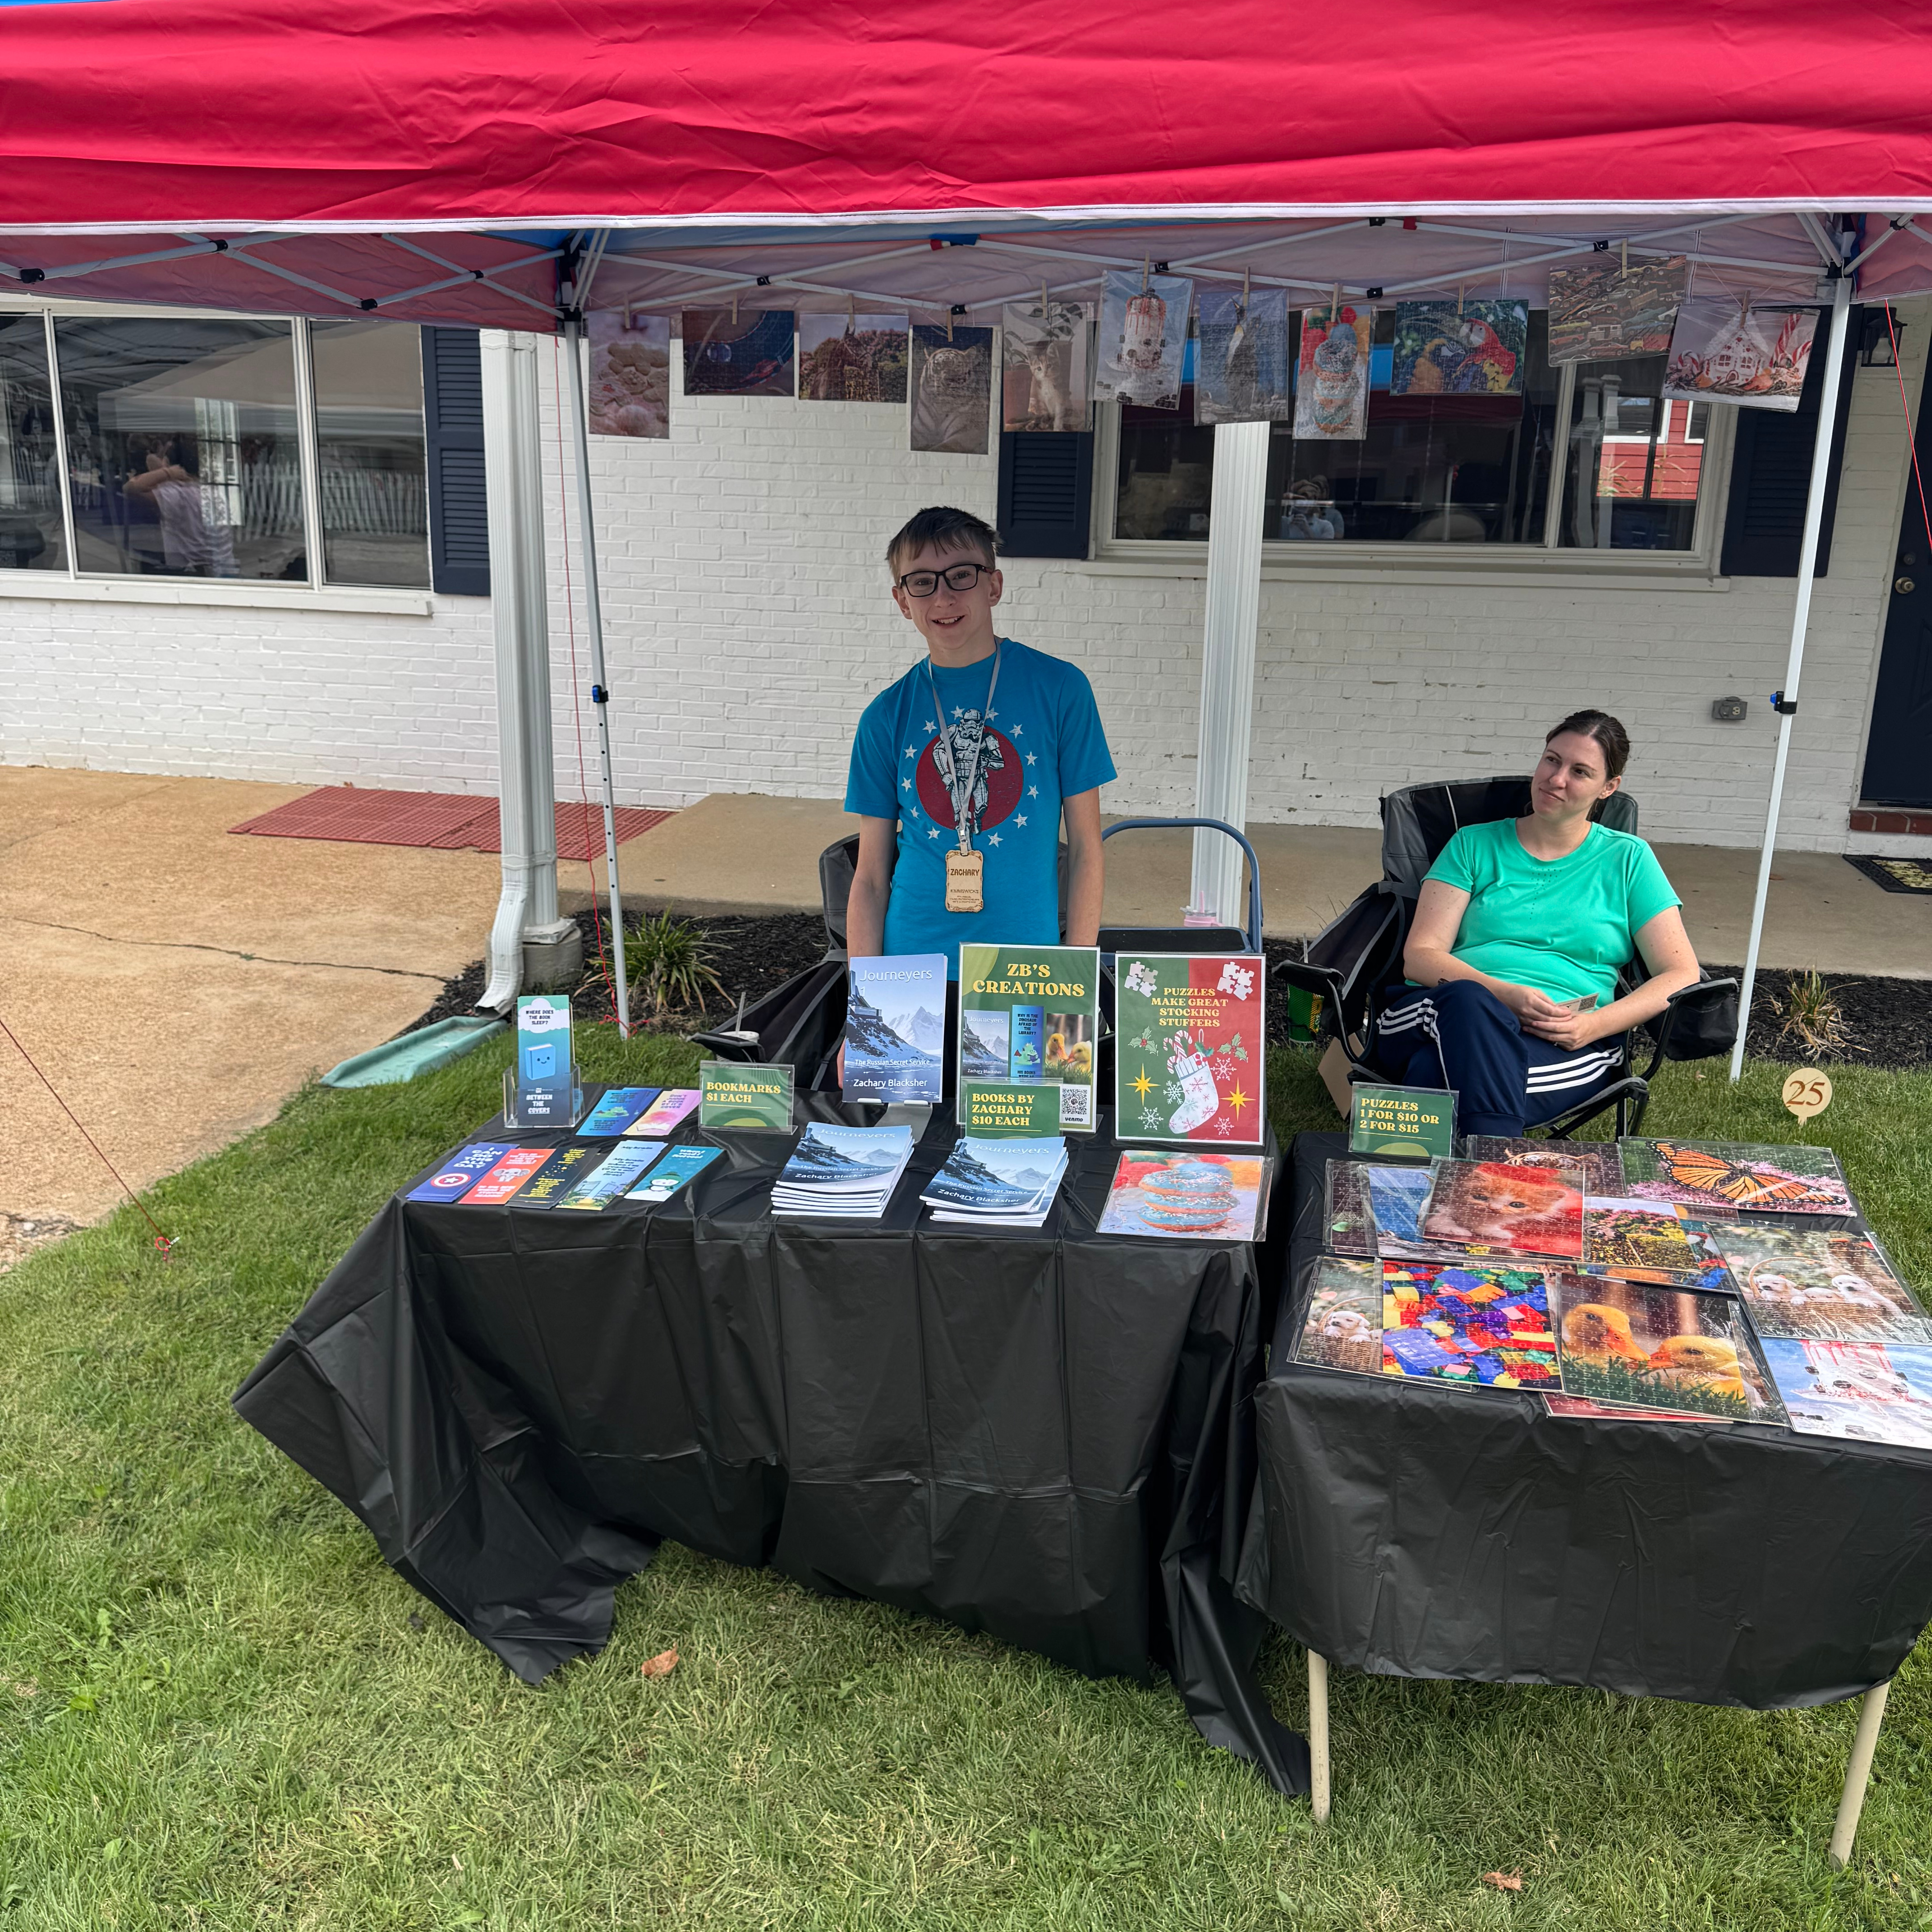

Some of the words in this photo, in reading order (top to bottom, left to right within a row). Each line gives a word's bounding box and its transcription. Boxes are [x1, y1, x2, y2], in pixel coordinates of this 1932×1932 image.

[1007, 963, 1050, 977] ZB'S
[860, 970, 933, 983] Journeyers
[860, 986, 865, 997] 1
[973, 980, 1085, 997] CREATIONS
[1164, 988, 1215, 996] PUZZLES
[1151, 998, 1186, 1006] MAKE
[1188, 998, 1228, 1007] GREAT
[1159, 1008, 1219, 1017] STOCKING
[1159, 1018, 1220, 1027] STUFFERS
[707, 1082, 781, 1094] BOOKMARKS
[853, 1079, 886, 1088] Zachary
[888, 1079, 928, 1087] Blacksher
[706, 1092, 718, 1101] $1
[720, 1094, 752, 1103] EACH
[972, 1093, 1015, 1103] BOOKS
[1017, 1095, 1035, 1103] BY
[1786, 1081, 1825, 1106] 25
[972, 1105, 1033, 1114] ZACHARY
[1362, 1098, 1418, 1111] PUZZLES
[972, 1115, 993, 1125] $10
[995, 1117, 1030, 1126] EACH
[1368, 1109, 1394, 1120] FOR
[1397, 1112, 1418, 1122] $10
[1421, 1114, 1440, 1124] OR
[1360, 1120, 1367, 1128] 2
[1370, 1121, 1395, 1131] FOR
[1398, 1123, 1419, 1133] $15
[818, 1129, 896, 1139] Journeyers
[971, 1144, 1050, 1155] Journeyers
[938, 1189, 974, 1201] Zachary
